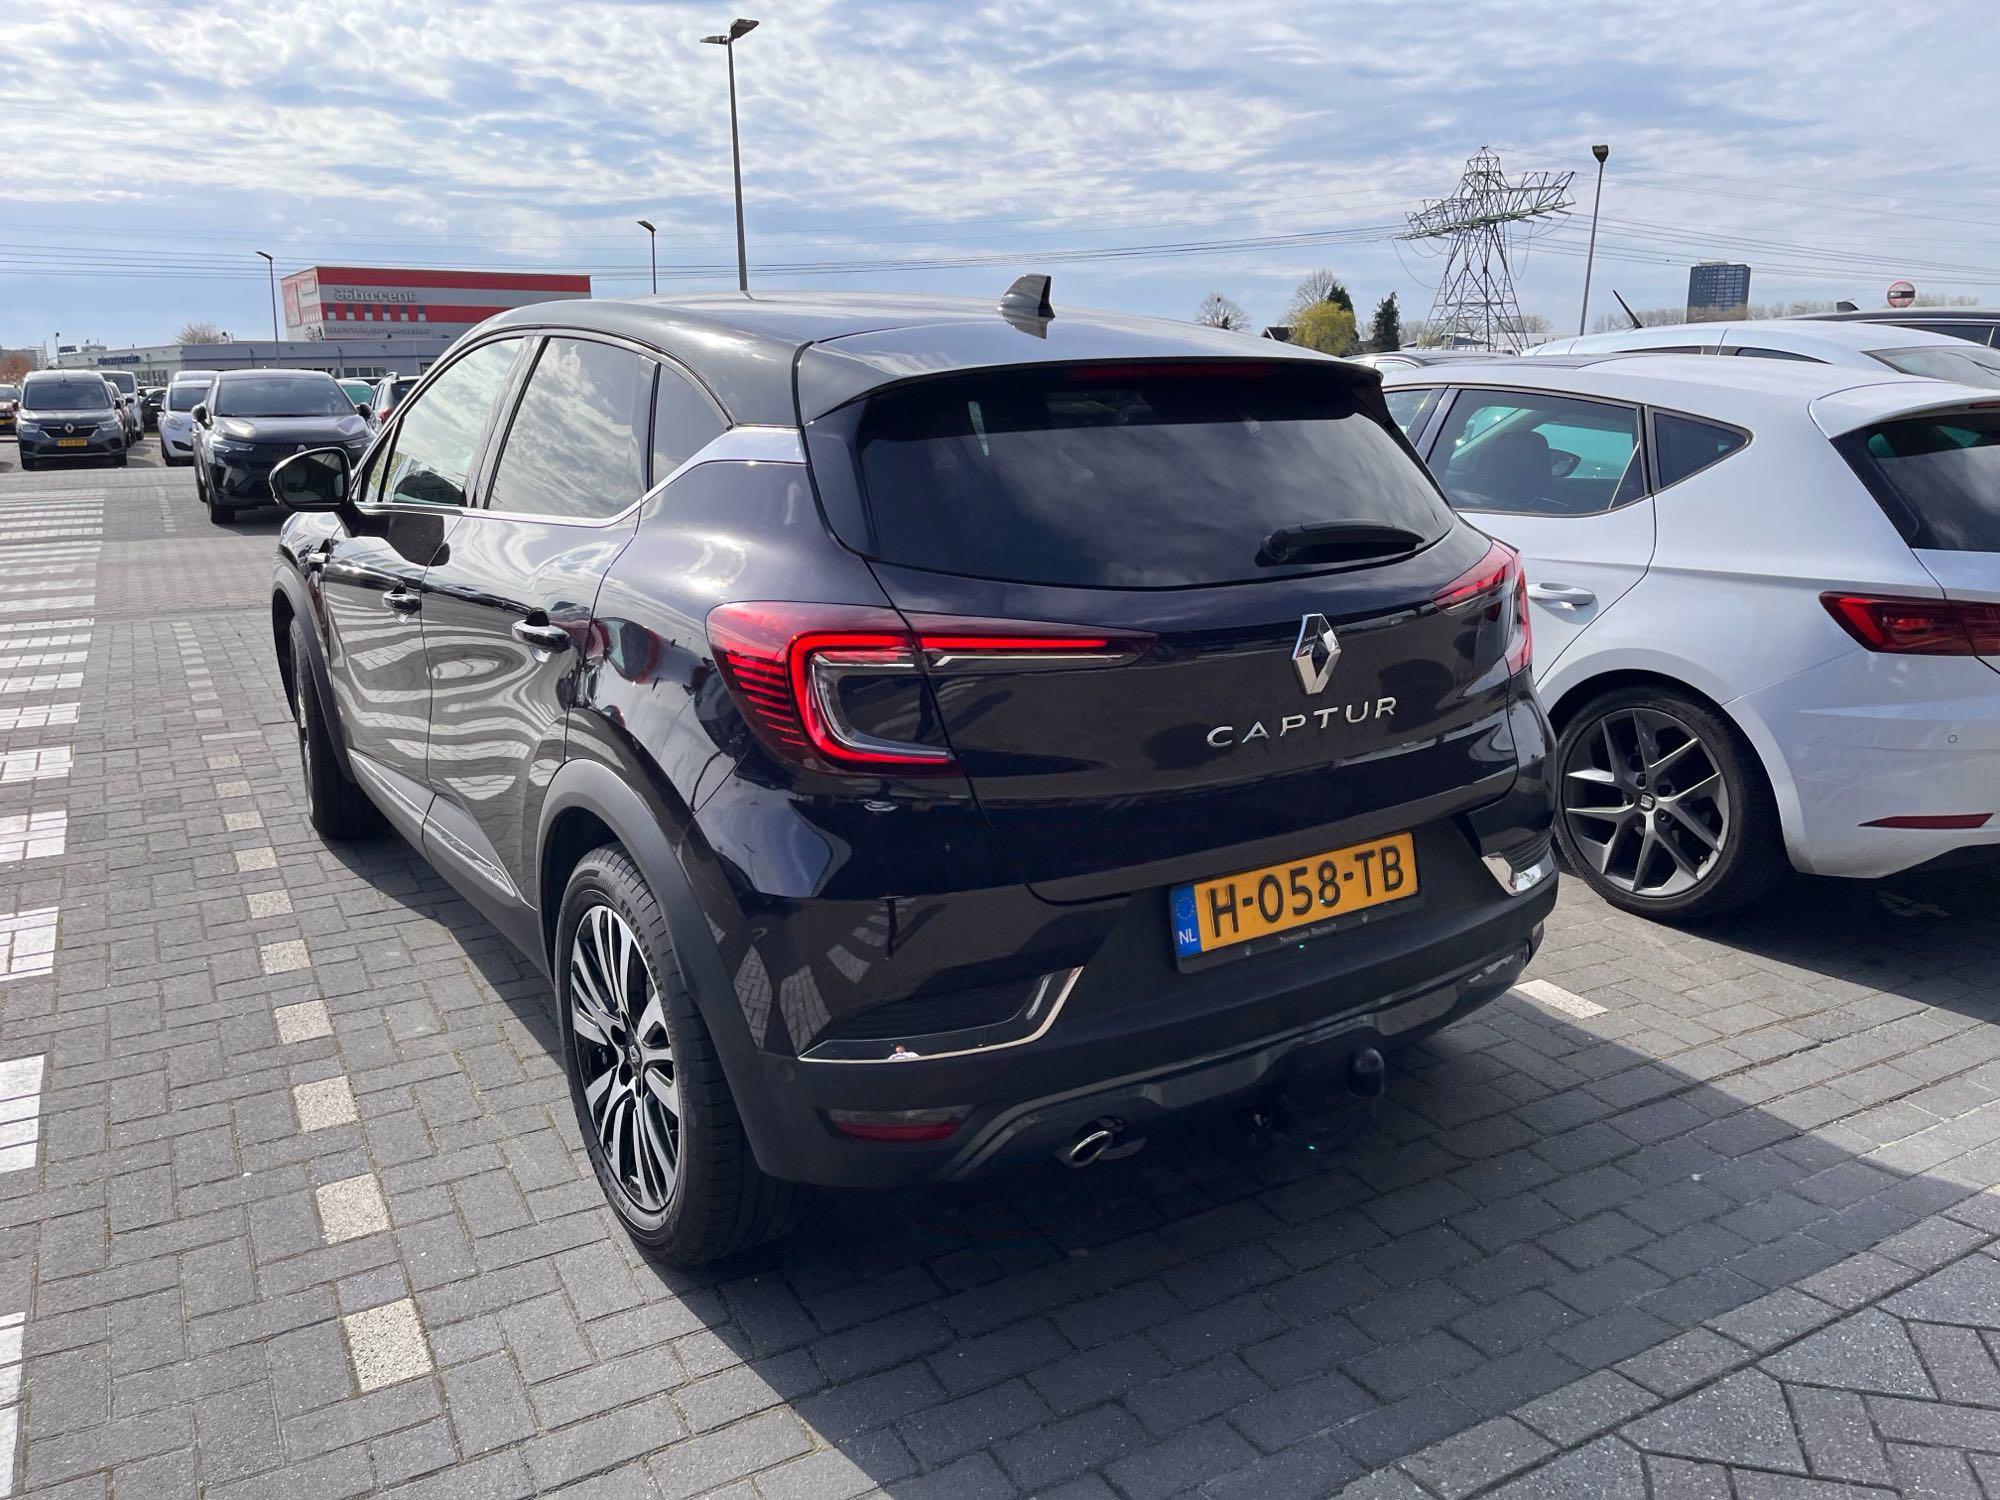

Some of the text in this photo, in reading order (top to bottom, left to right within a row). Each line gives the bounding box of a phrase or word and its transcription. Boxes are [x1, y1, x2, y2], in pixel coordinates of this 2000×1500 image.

[1206, 696, 1397, 748] CAPTUR
[1207, 845, 1405, 938] H-058-TB
[1179, 929, 1197, 945] NL
